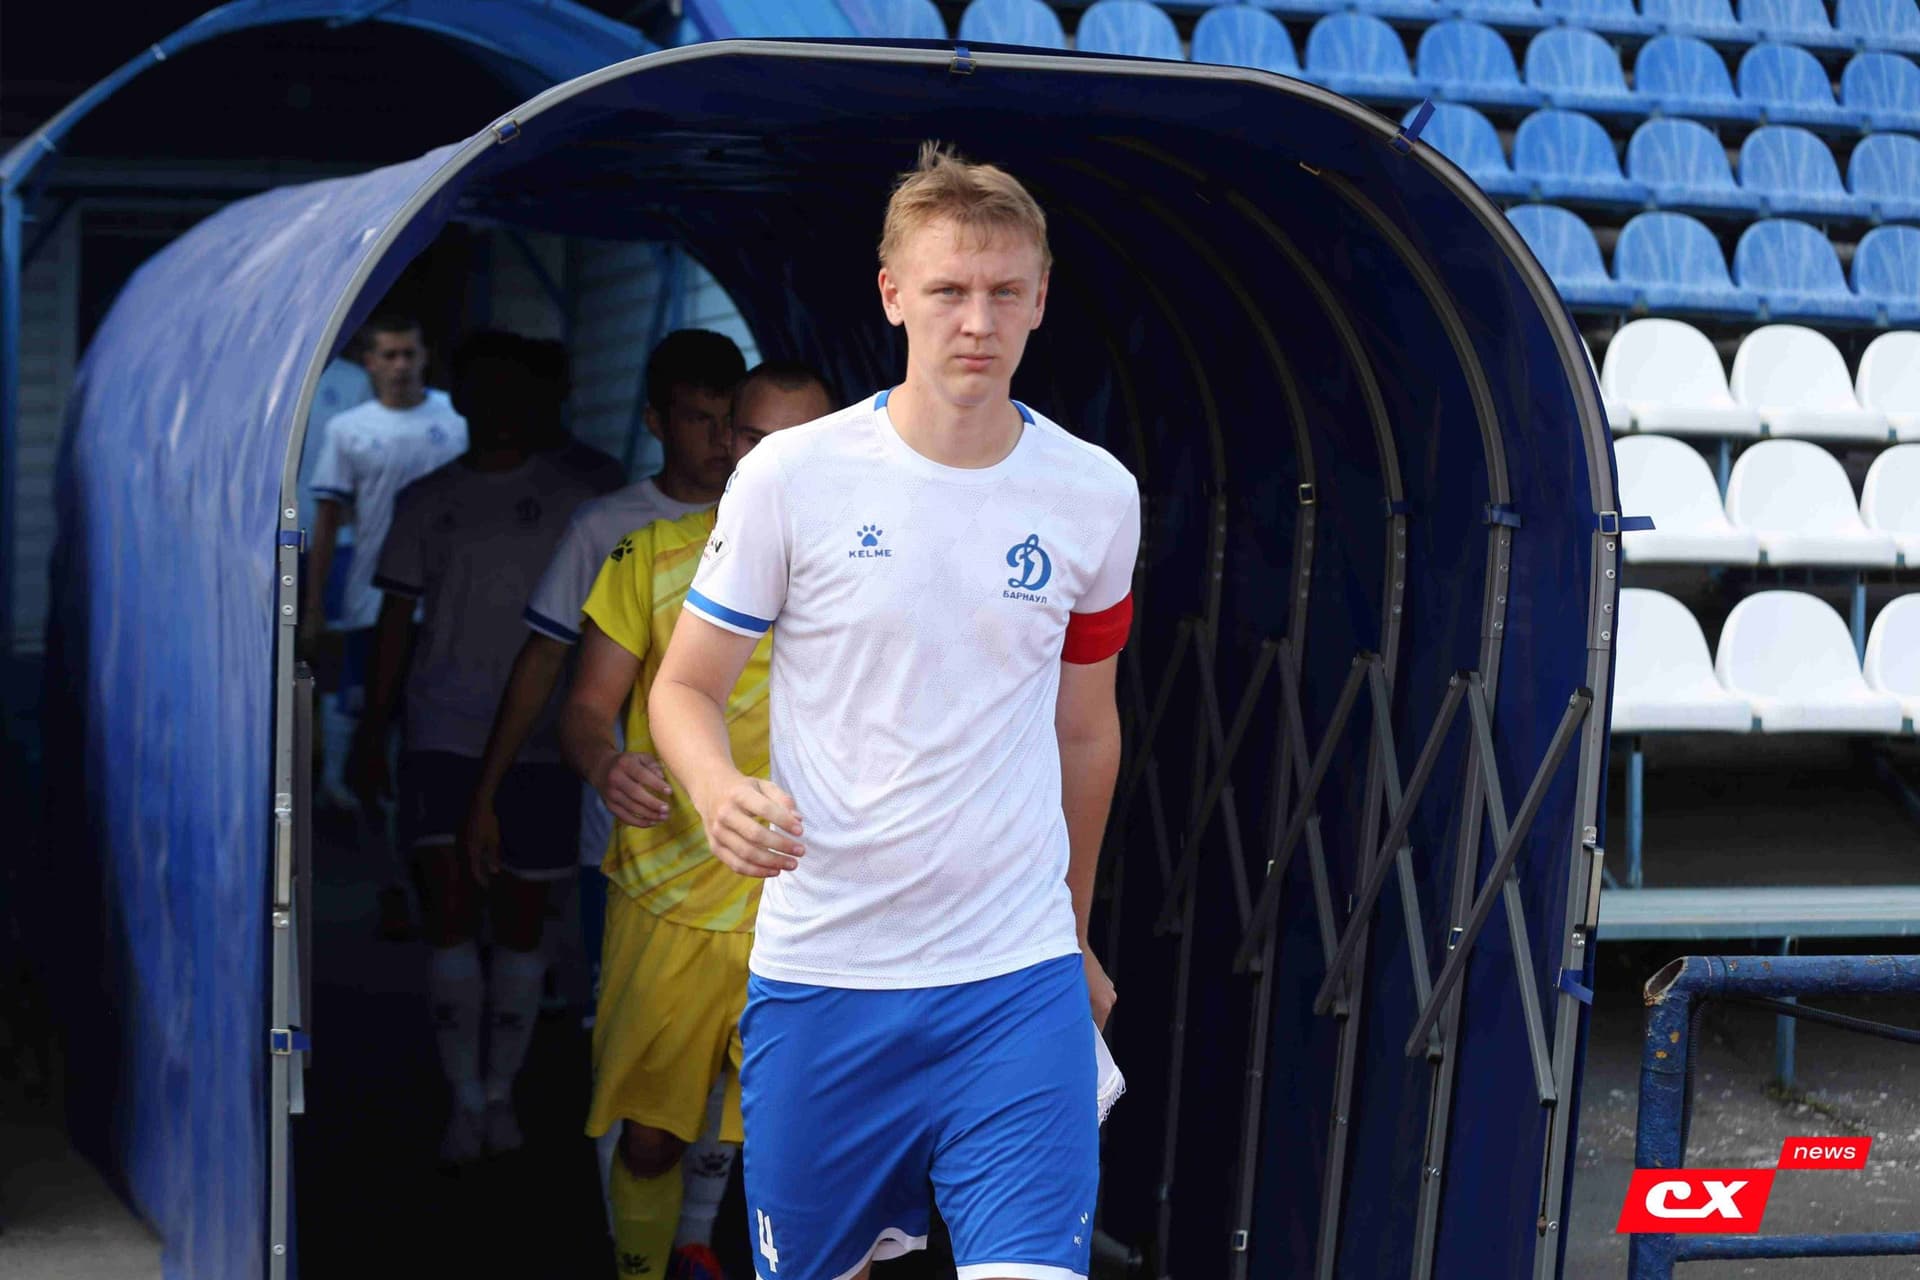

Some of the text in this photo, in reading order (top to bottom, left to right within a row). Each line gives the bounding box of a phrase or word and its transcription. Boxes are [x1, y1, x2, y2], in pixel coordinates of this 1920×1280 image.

[848, 549, 892, 558] KELME
[1003, 590, 1048, 604] БАРНАУЛ
[756, 1208, 779, 1273] 4
